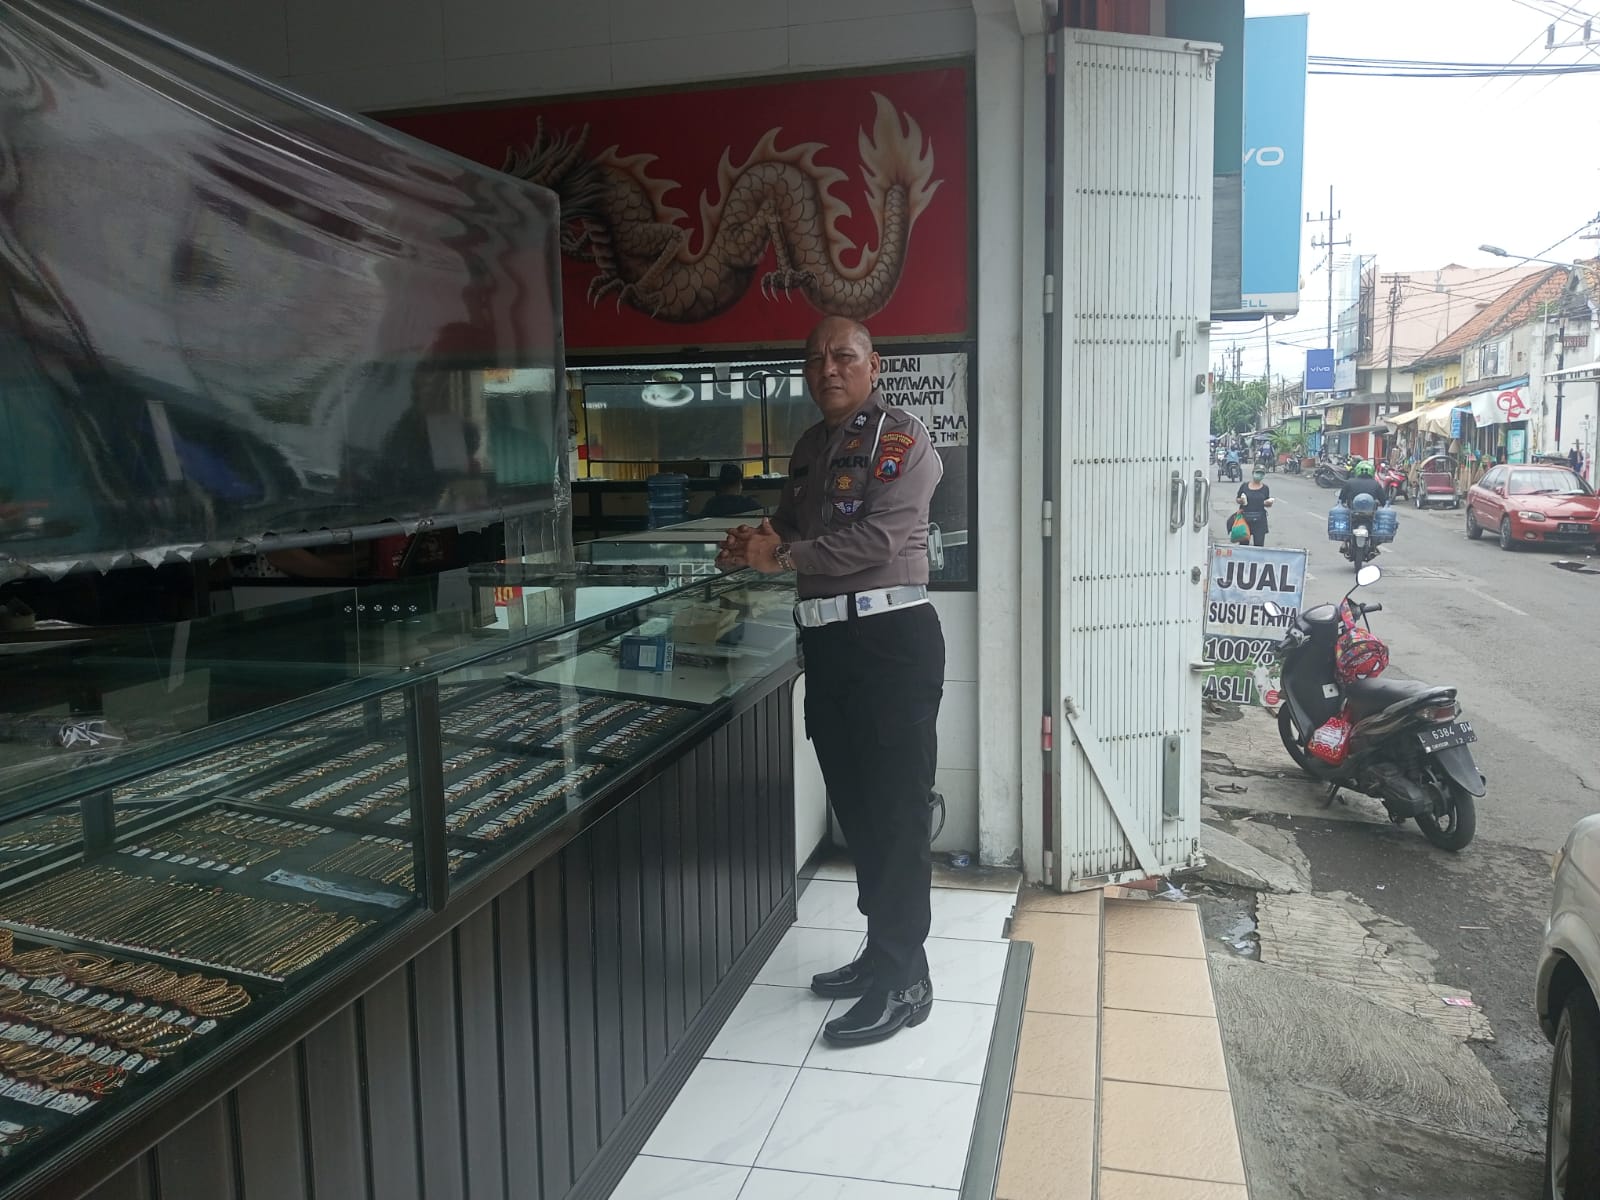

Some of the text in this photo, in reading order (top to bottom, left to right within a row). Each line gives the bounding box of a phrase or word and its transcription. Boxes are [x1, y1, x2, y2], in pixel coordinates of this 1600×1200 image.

[1241, 298, 1268, 308] ELL
[879, 357, 920, 373] DICARI
[1310, 365, 1330, 373] vivo
[933, 414, 967, 429] SMA
[831, 455, 869, 470] POLRI
[1216, 560, 1296, 593] JUAL
[1209, 602, 1247, 625] SUSU
[1206, 638, 1274, 665] 100%
[1203, 675, 1252, 703] ASLI
